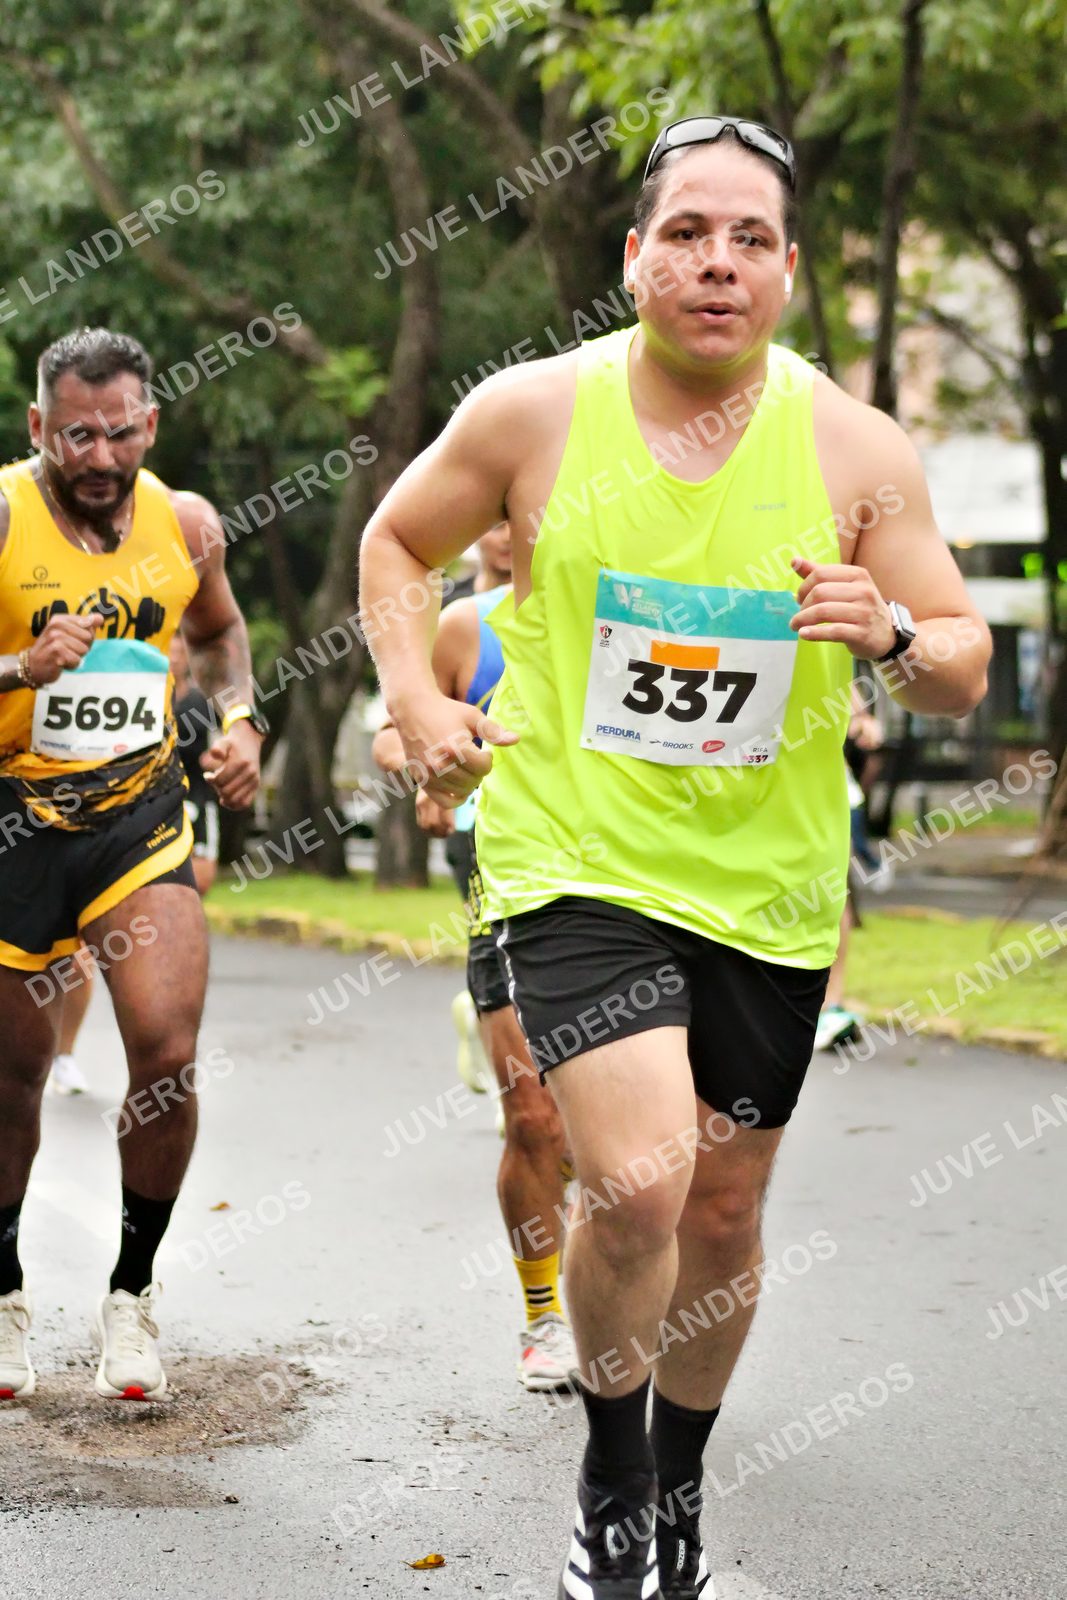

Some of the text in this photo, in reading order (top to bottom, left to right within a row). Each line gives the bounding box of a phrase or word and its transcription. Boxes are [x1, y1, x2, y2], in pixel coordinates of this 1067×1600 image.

[622, 658, 757, 723] 337
[43, 695, 156, 731] 5694
[596, 724, 641, 741] PERDURA
[662, 740, 694, 750] BROOKS
[747, 754, 769, 764] 337
